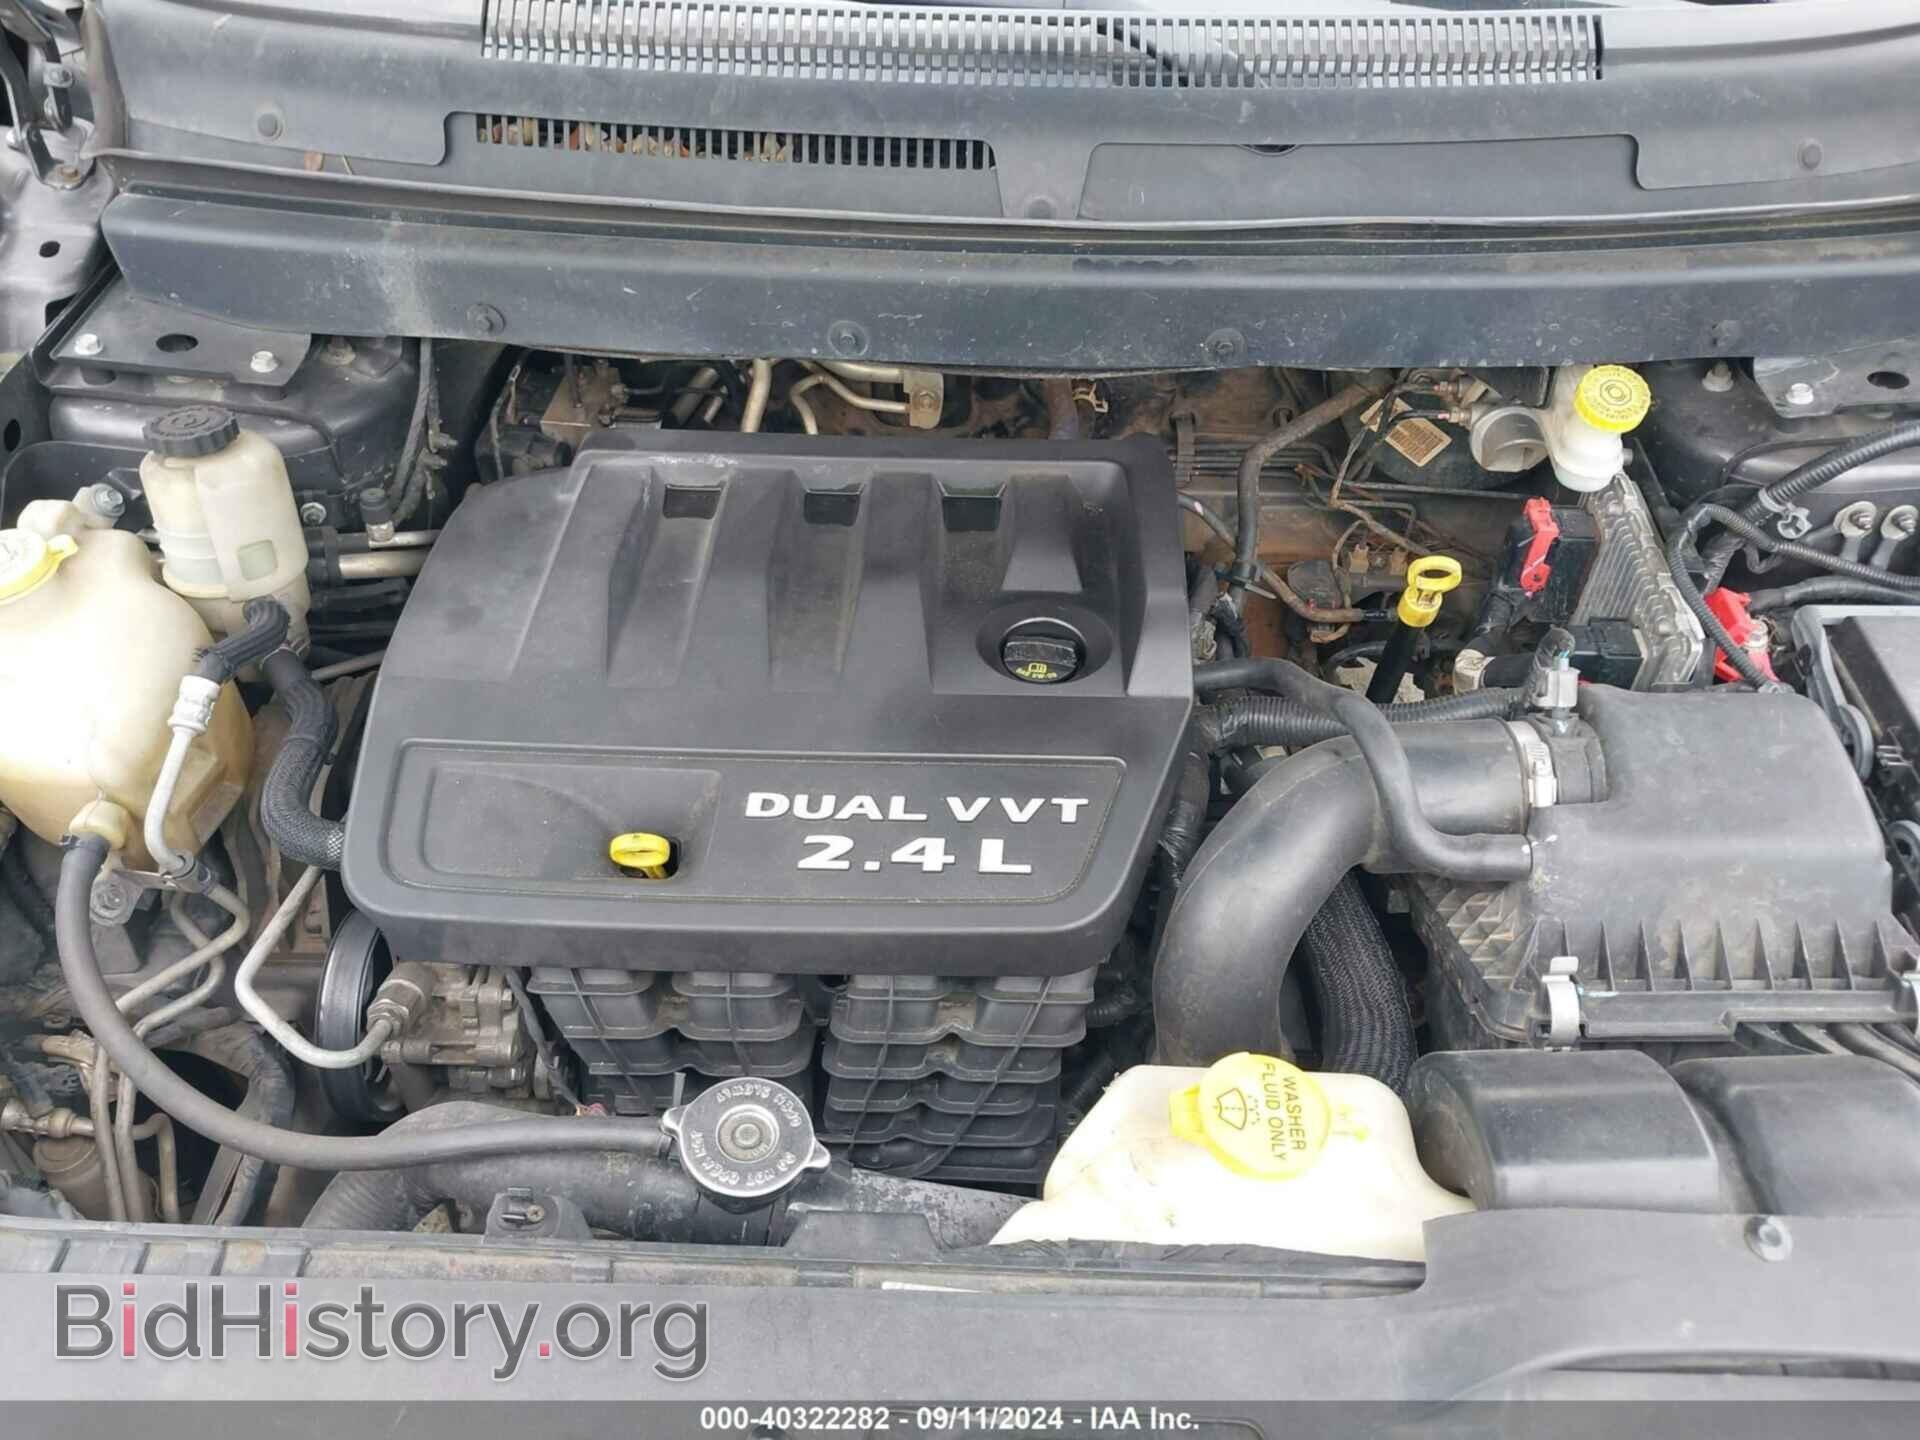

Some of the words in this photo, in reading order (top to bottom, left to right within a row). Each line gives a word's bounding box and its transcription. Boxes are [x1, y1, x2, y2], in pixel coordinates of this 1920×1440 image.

[745, 791, 928, 821] DUAL
[946, 796, 1090, 823] VVT
[1261, 1063, 1281, 1111] FLUID
[1282, 1076, 1307, 1151] WASHER
[1268, 1116, 1288, 1161] ONLY
